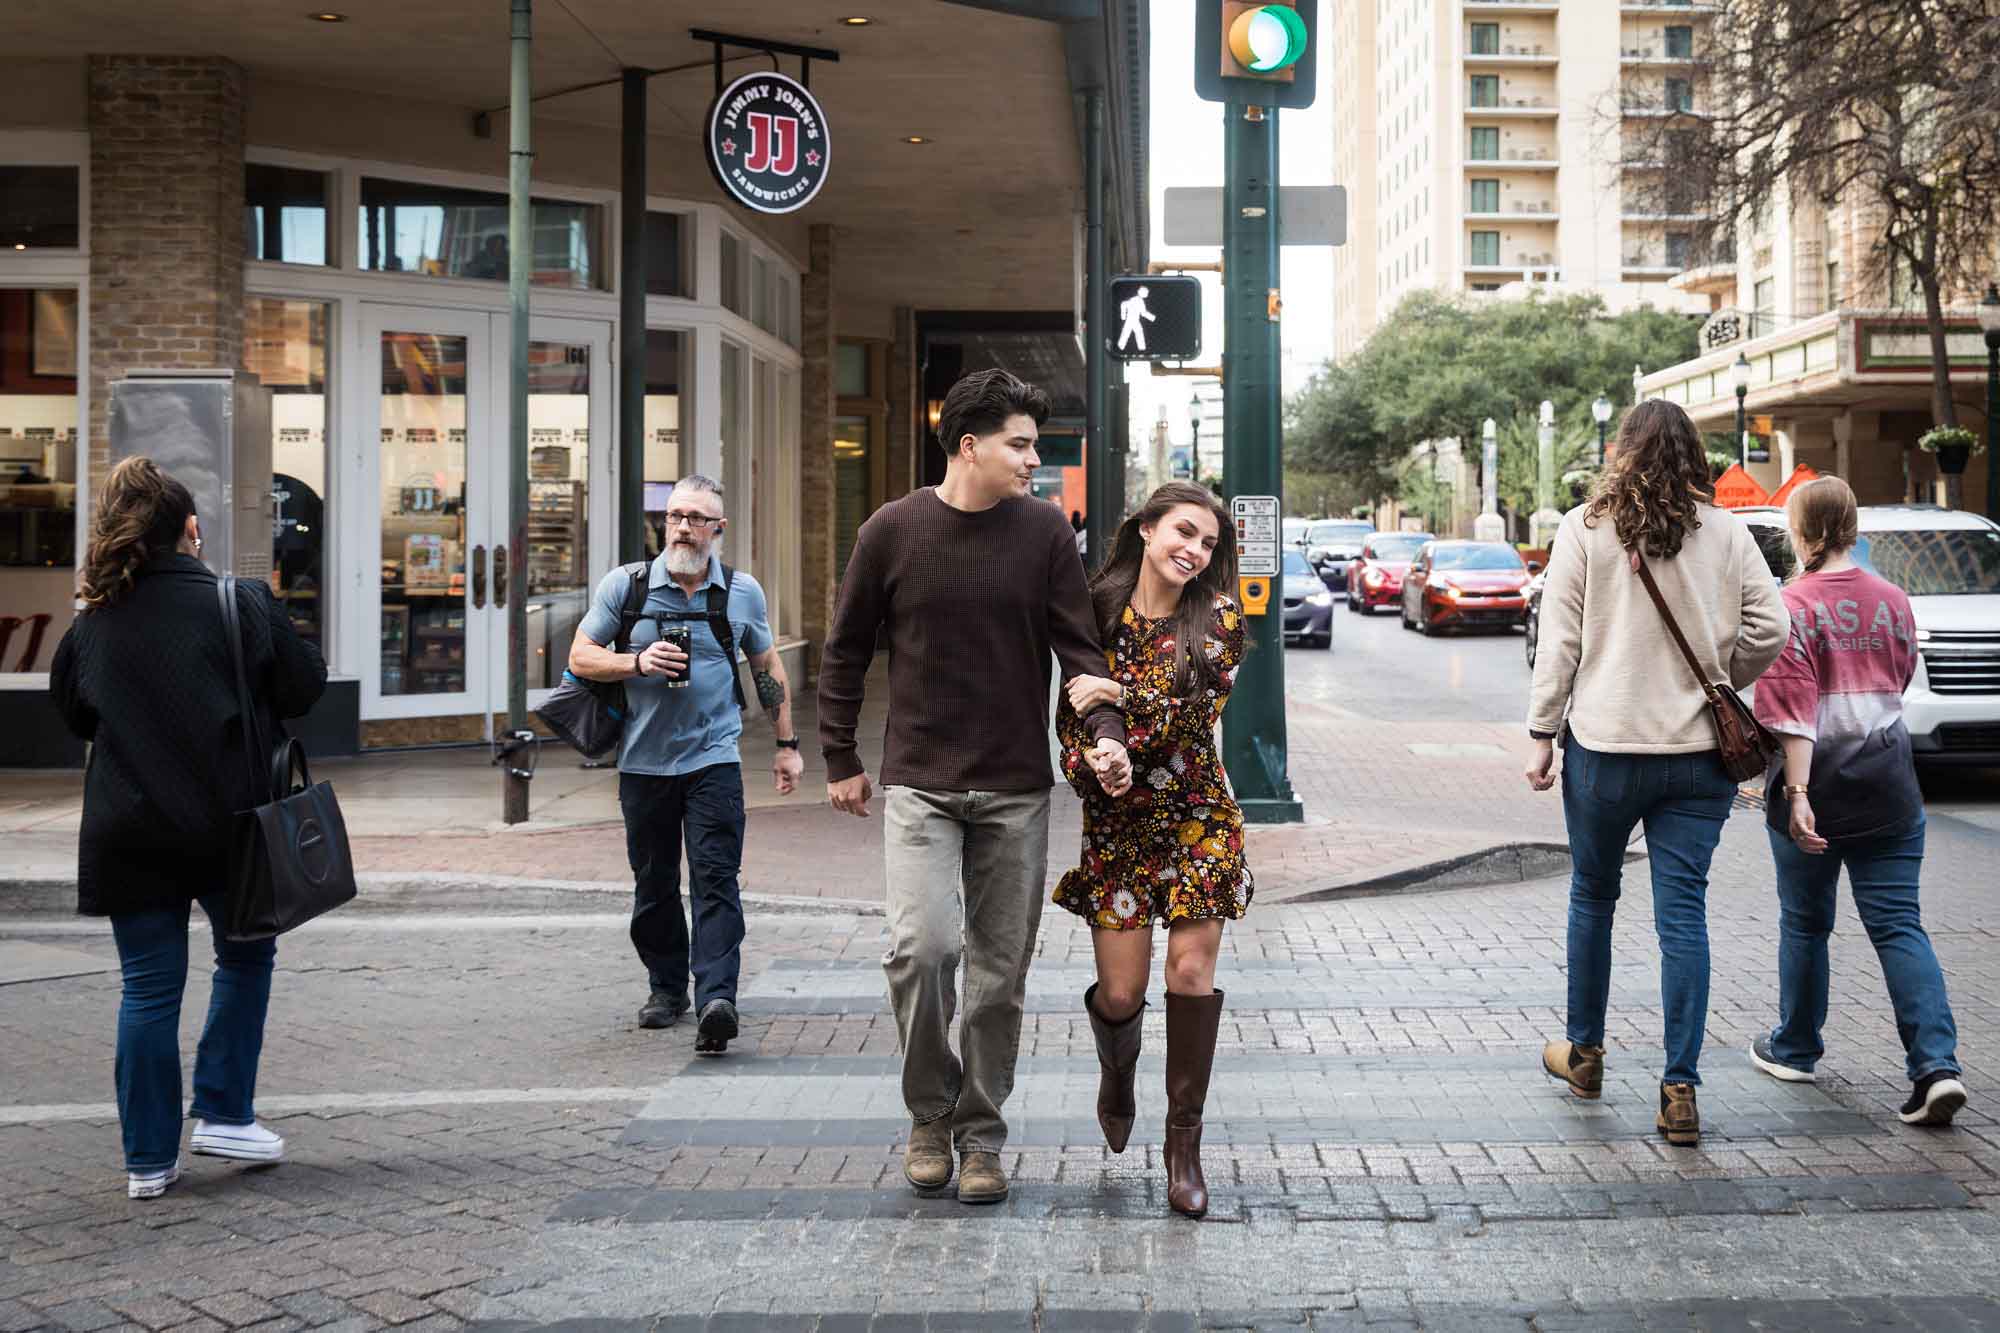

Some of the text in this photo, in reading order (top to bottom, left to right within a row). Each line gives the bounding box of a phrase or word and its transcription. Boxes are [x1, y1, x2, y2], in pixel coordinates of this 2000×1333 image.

[723, 84, 819, 139] JIMMY JOHN'S
[744, 111, 798, 176] JJ
[732, 168, 810, 201] SANDWICHES
